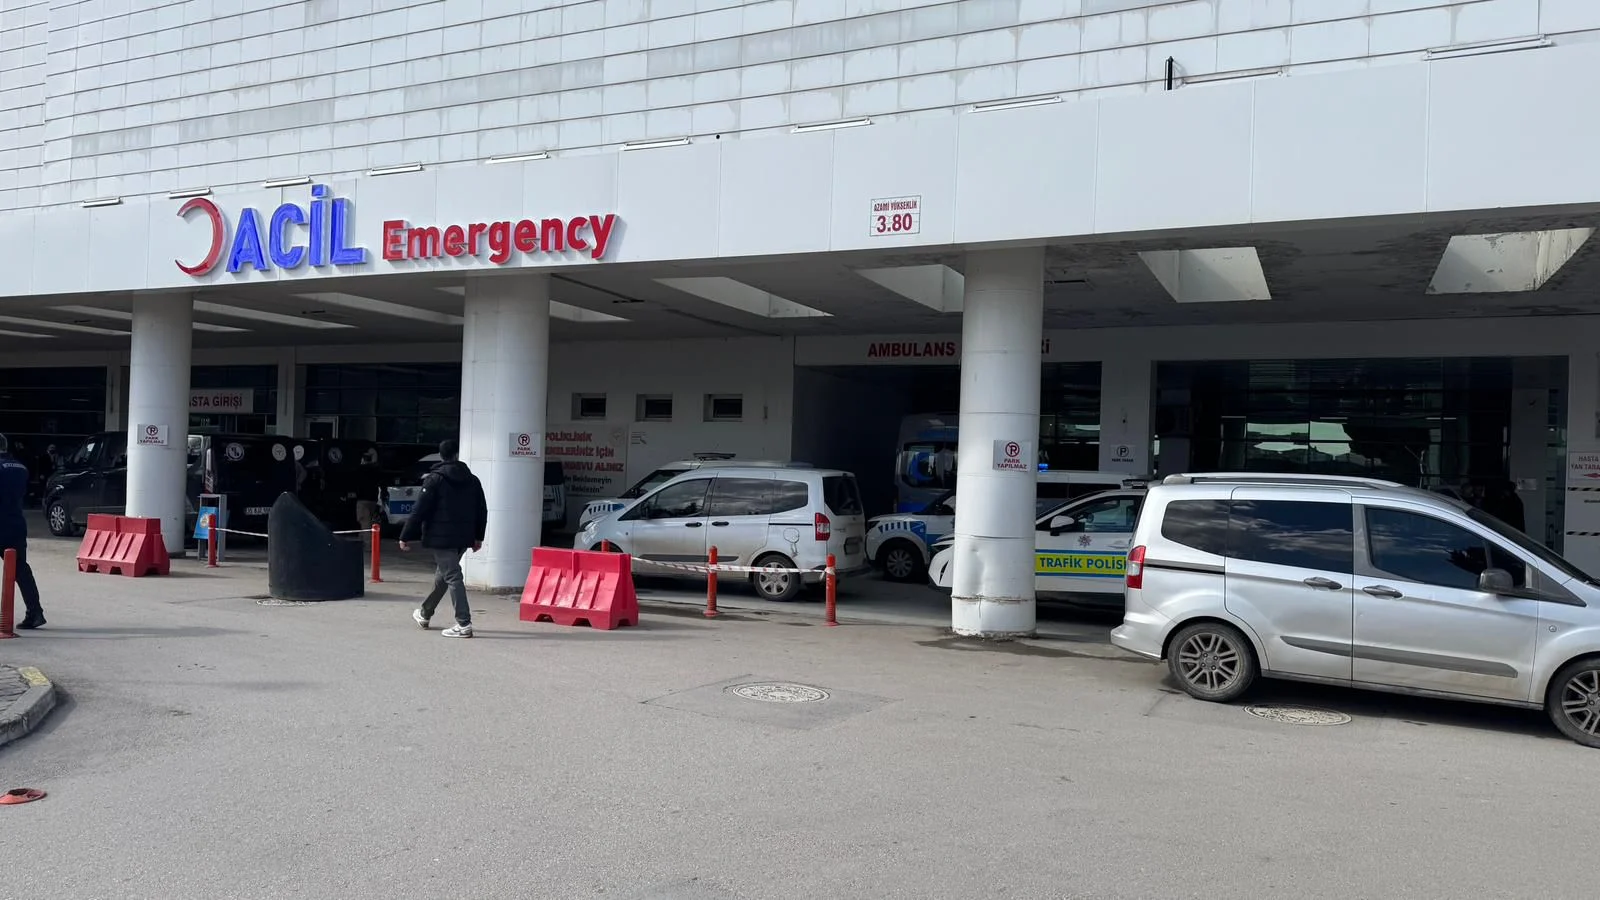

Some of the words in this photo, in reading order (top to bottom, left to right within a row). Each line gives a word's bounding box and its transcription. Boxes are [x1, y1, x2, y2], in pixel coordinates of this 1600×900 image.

[873, 201, 890, 211] AZAMİ
[225, 183, 368, 273] ACİL
[382, 213, 616, 264] Emergency
[876, 212, 913, 233] 3.80
[867, 341, 956, 358] AMBULANS
[212, 393, 243, 410] GİRİŞİ
[1039, 555, 1082, 568] TRAFİK
[1086, 556, 1126, 570] POLİSİ
